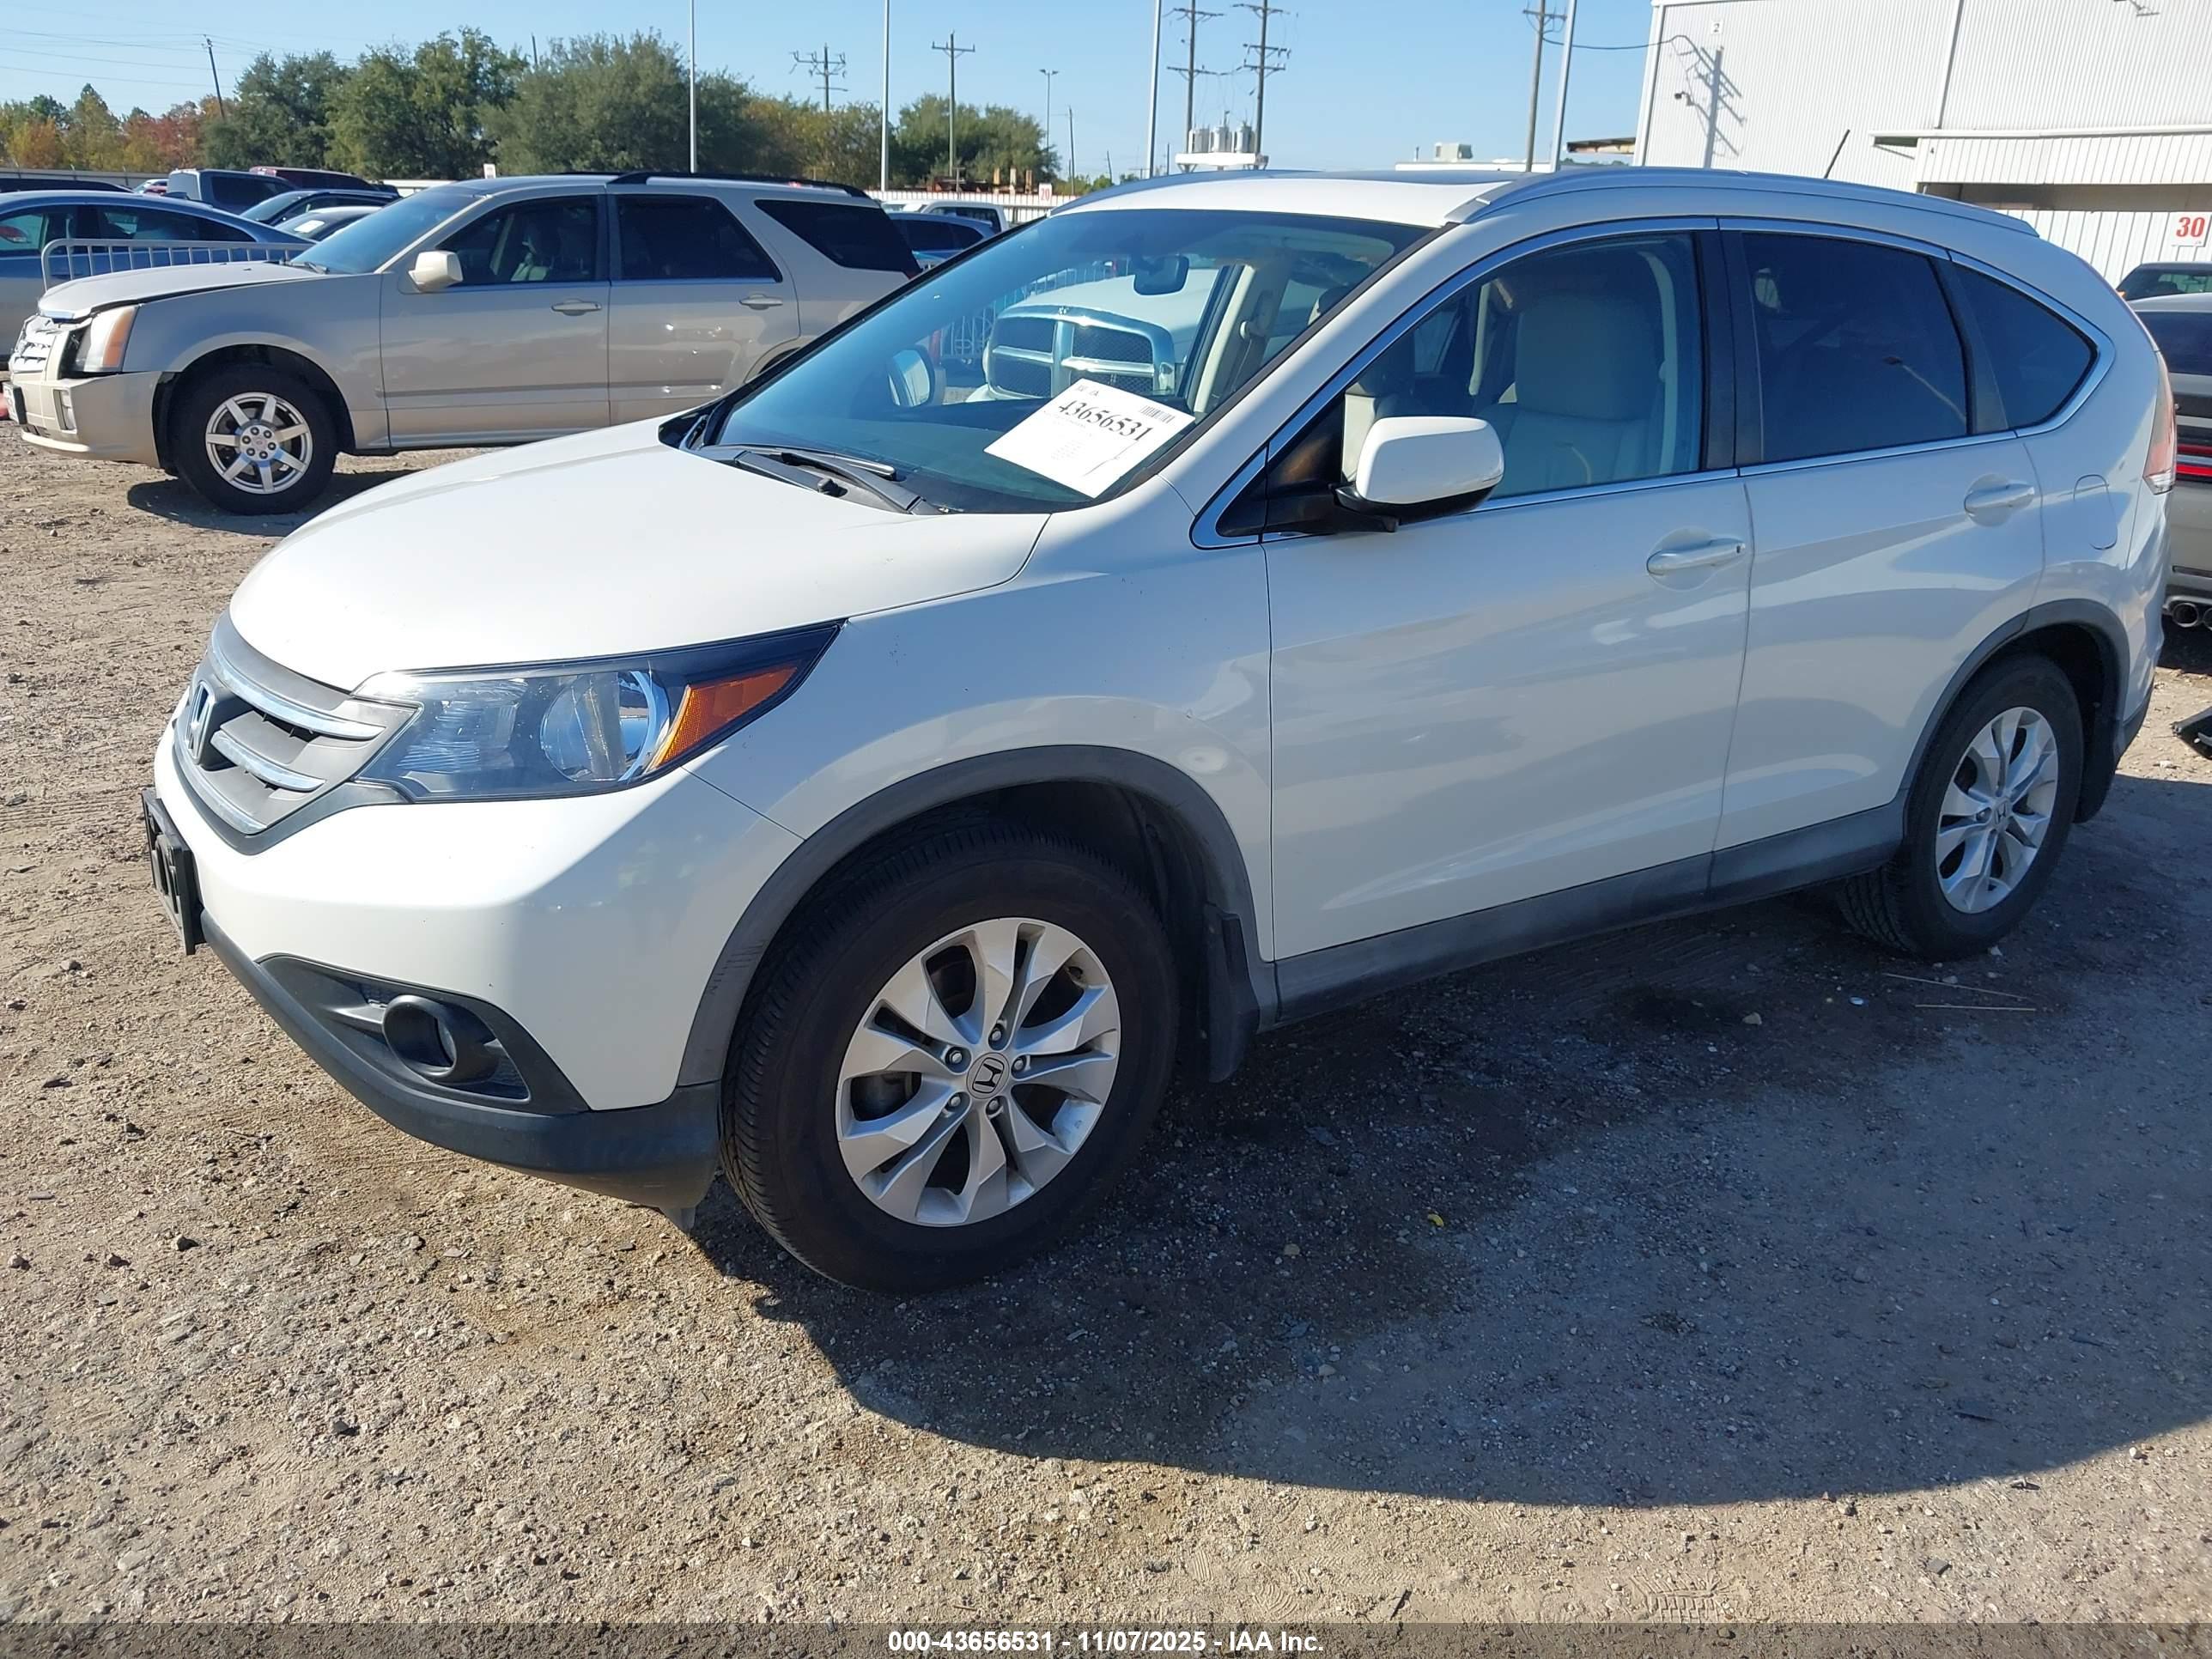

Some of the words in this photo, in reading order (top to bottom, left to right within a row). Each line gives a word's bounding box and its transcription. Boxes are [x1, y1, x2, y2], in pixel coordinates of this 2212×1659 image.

[1713, 22, 1720, 33] 2
[1040, 187, 1050, 201] 20
[2175, 216, 2206, 238] 30
[1057, 399, 1154, 441] 43656531
